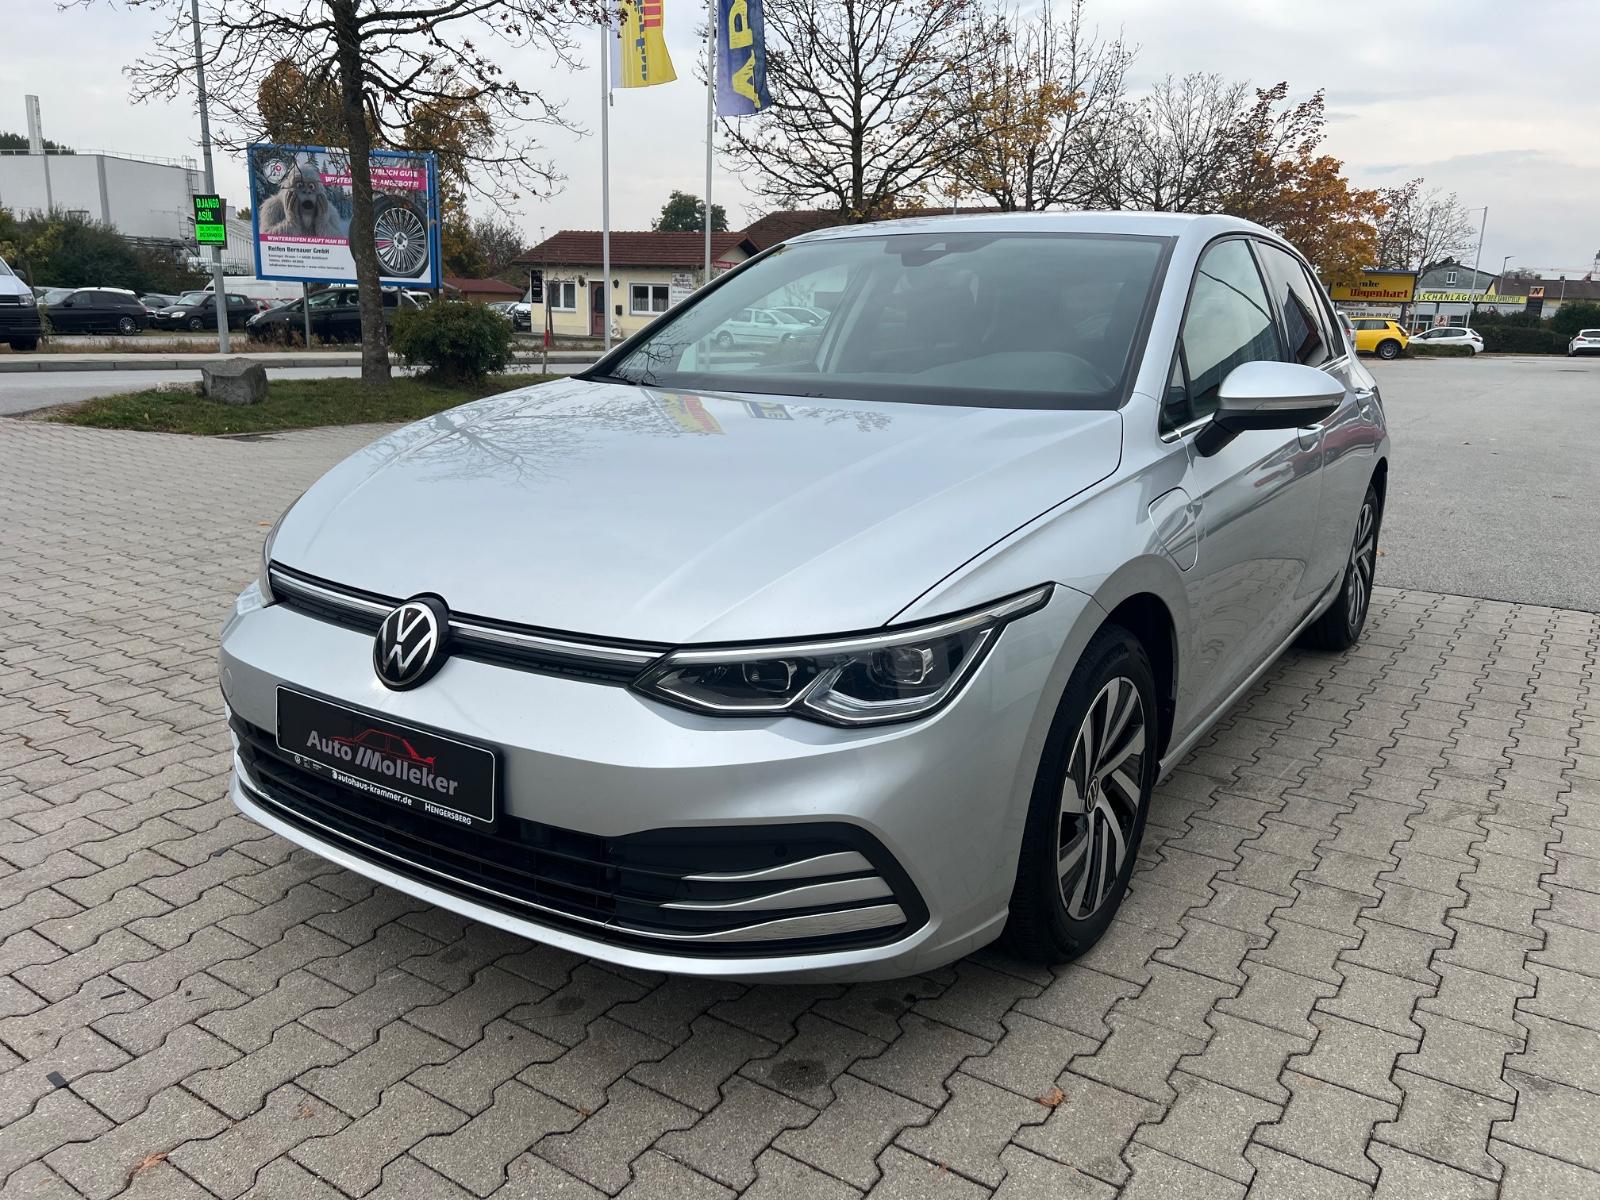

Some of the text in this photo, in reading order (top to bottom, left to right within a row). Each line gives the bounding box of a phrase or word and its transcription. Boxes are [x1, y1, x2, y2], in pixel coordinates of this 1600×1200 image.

[267, 235, 307, 243] WINTERREIFEN
[1417, 292, 1481, 302] SCHANLAGEN
[306, 730, 353, 761] Auto
[337, 774, 472, 825] autohaus-krammer.de HENGERSBERG
